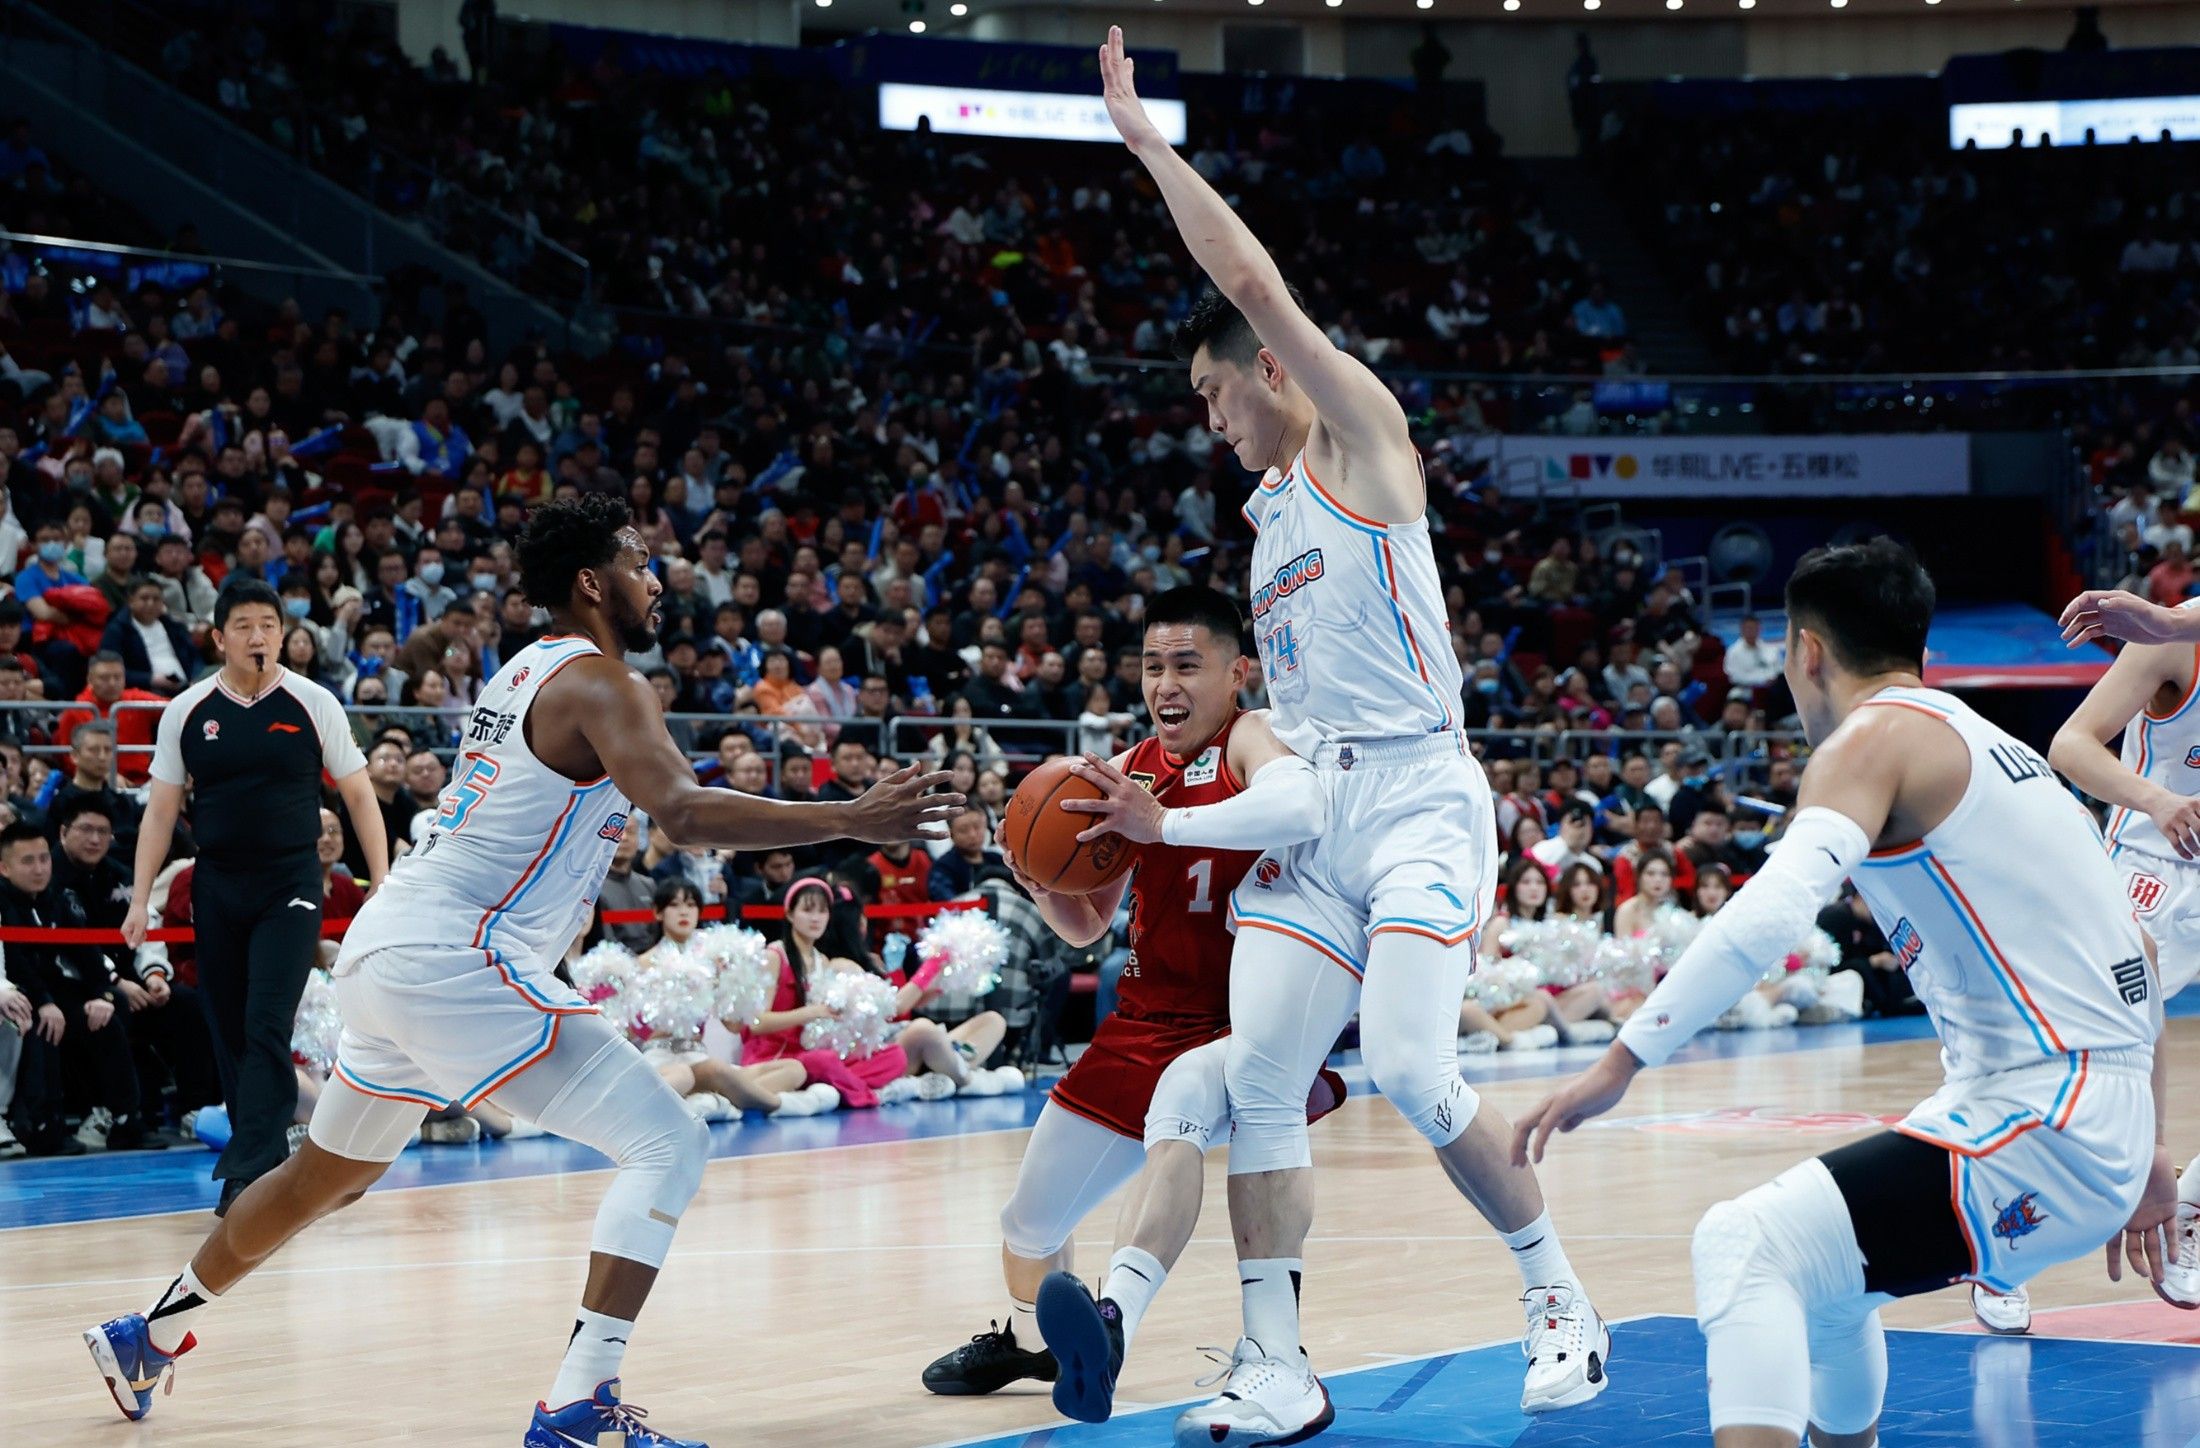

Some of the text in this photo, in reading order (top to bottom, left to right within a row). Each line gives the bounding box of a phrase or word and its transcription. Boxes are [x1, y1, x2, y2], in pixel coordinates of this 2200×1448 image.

[1264, 620, 1299, 683] 14
[1187, 859, 1213, 913] 1
[2110, 956, 2147, 1007] 高
